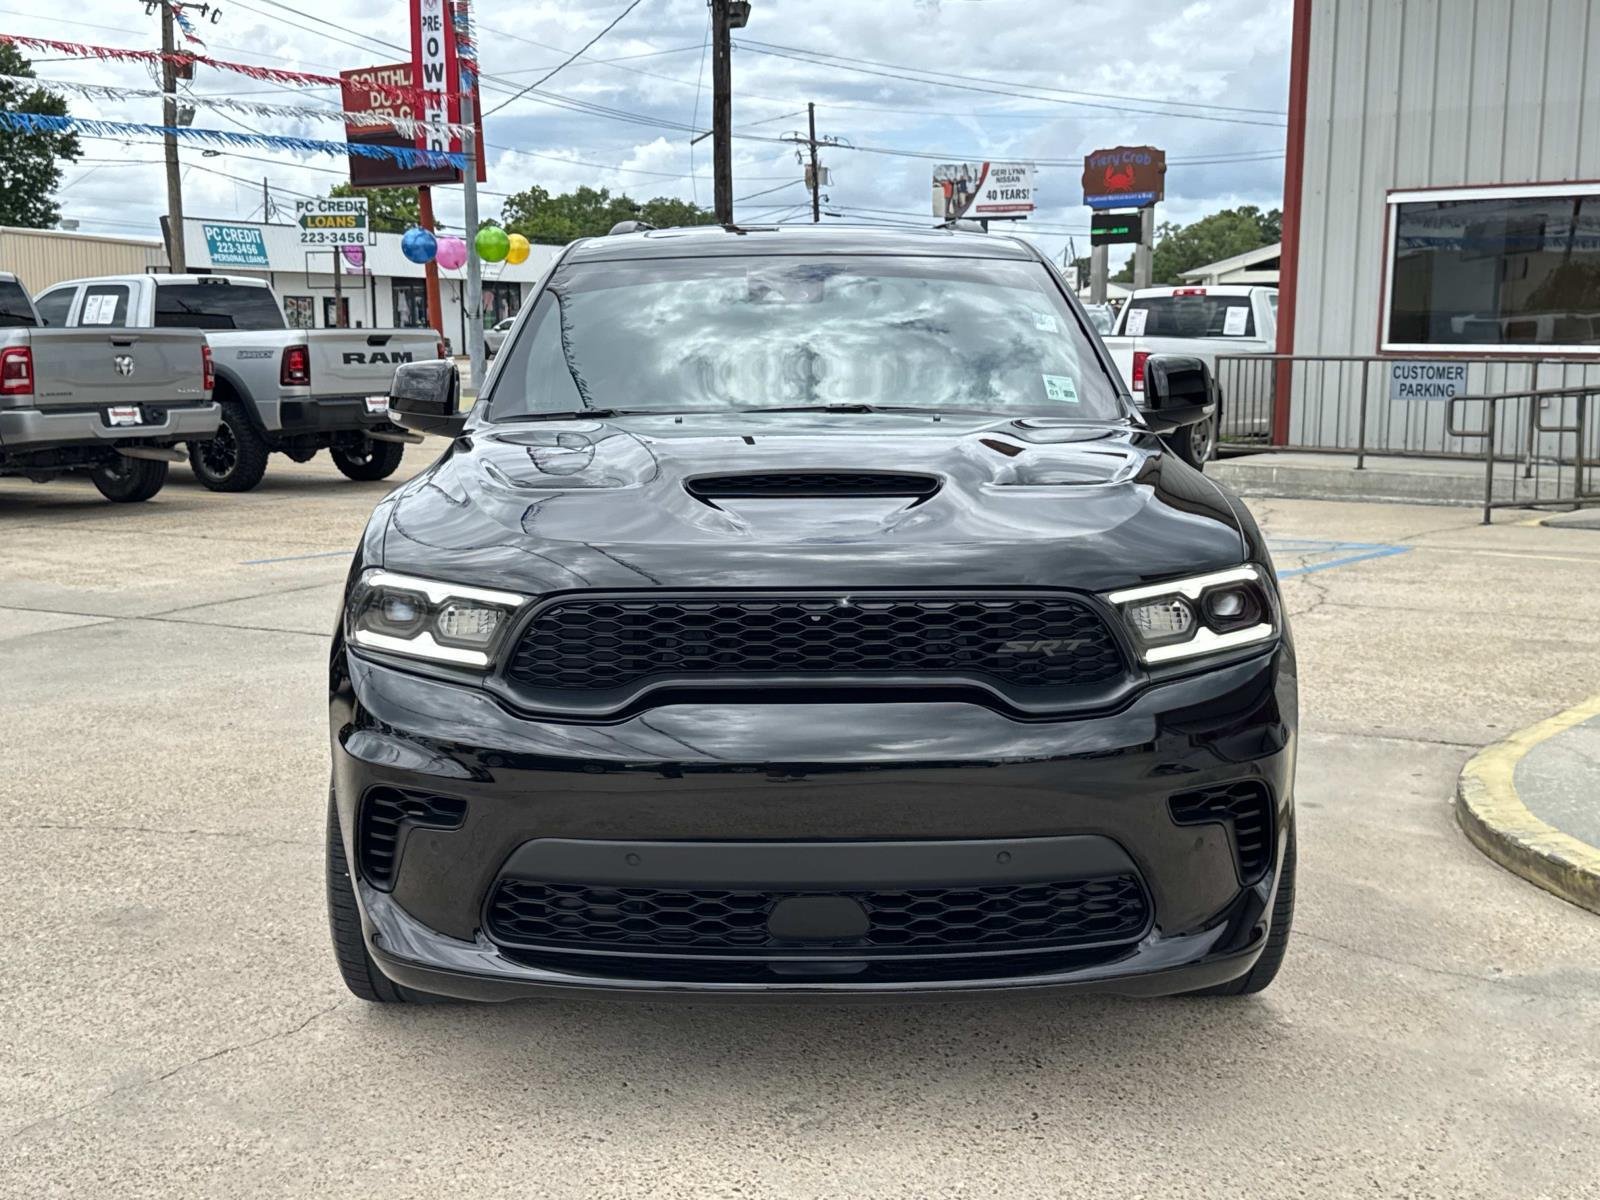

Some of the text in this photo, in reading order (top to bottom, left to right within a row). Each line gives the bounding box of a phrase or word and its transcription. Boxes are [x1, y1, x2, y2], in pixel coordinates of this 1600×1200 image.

[350, 69, 414, 92] SOUTHL
[986, 188, 1030, 201] 40 YEARS!
[296, 200, 366, 213] PC CREDIT
[307, 216, 356, 227] LOANS
[205, 226, 261, 244] PC CREDIT
[300, 232, 365, 244] 223-3456
[216, 242, 258, 255] 223-3456
[342, 352, 413, 365] RAM
[1393, 365, 1464, 380] CUSTOMER
[1399, 383, 1456, 398] PARKING
[996, 639, 1092, 657] SRT
